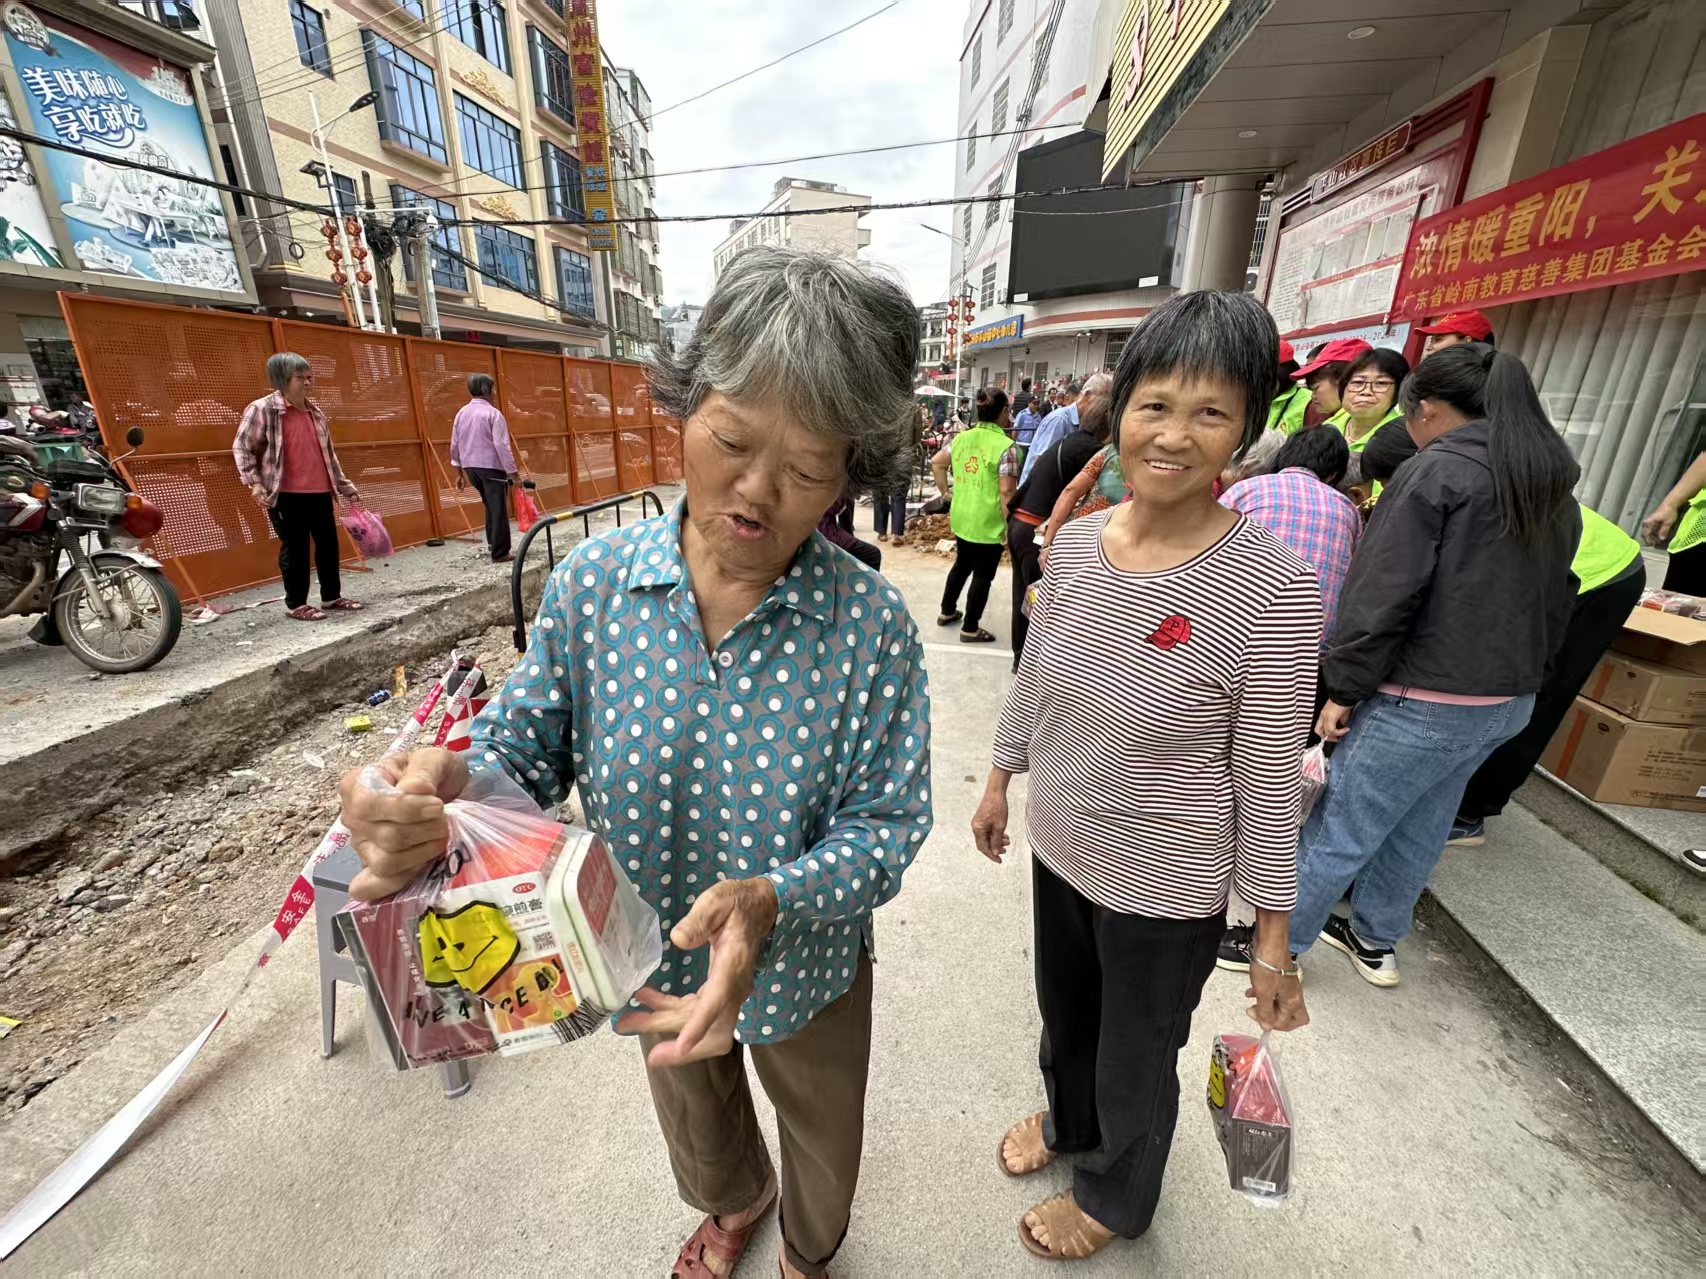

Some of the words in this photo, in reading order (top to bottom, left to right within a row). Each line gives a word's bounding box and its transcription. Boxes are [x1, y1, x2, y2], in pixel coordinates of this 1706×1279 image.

[21, 66, 129, 107] 美味随心
[44, 101, 147, 142] 享吃就吃
[1633, 139, 1706, 225] 关
[1401, 224, 1706, 312] 广东省岭南教育慈善集团基金会
[437, 721, 451, 742] SAF
[281, 889, 306, 925] 安全
[515, 884, 533, 892] OTC
[286, 896, 312, 935] SAFE
